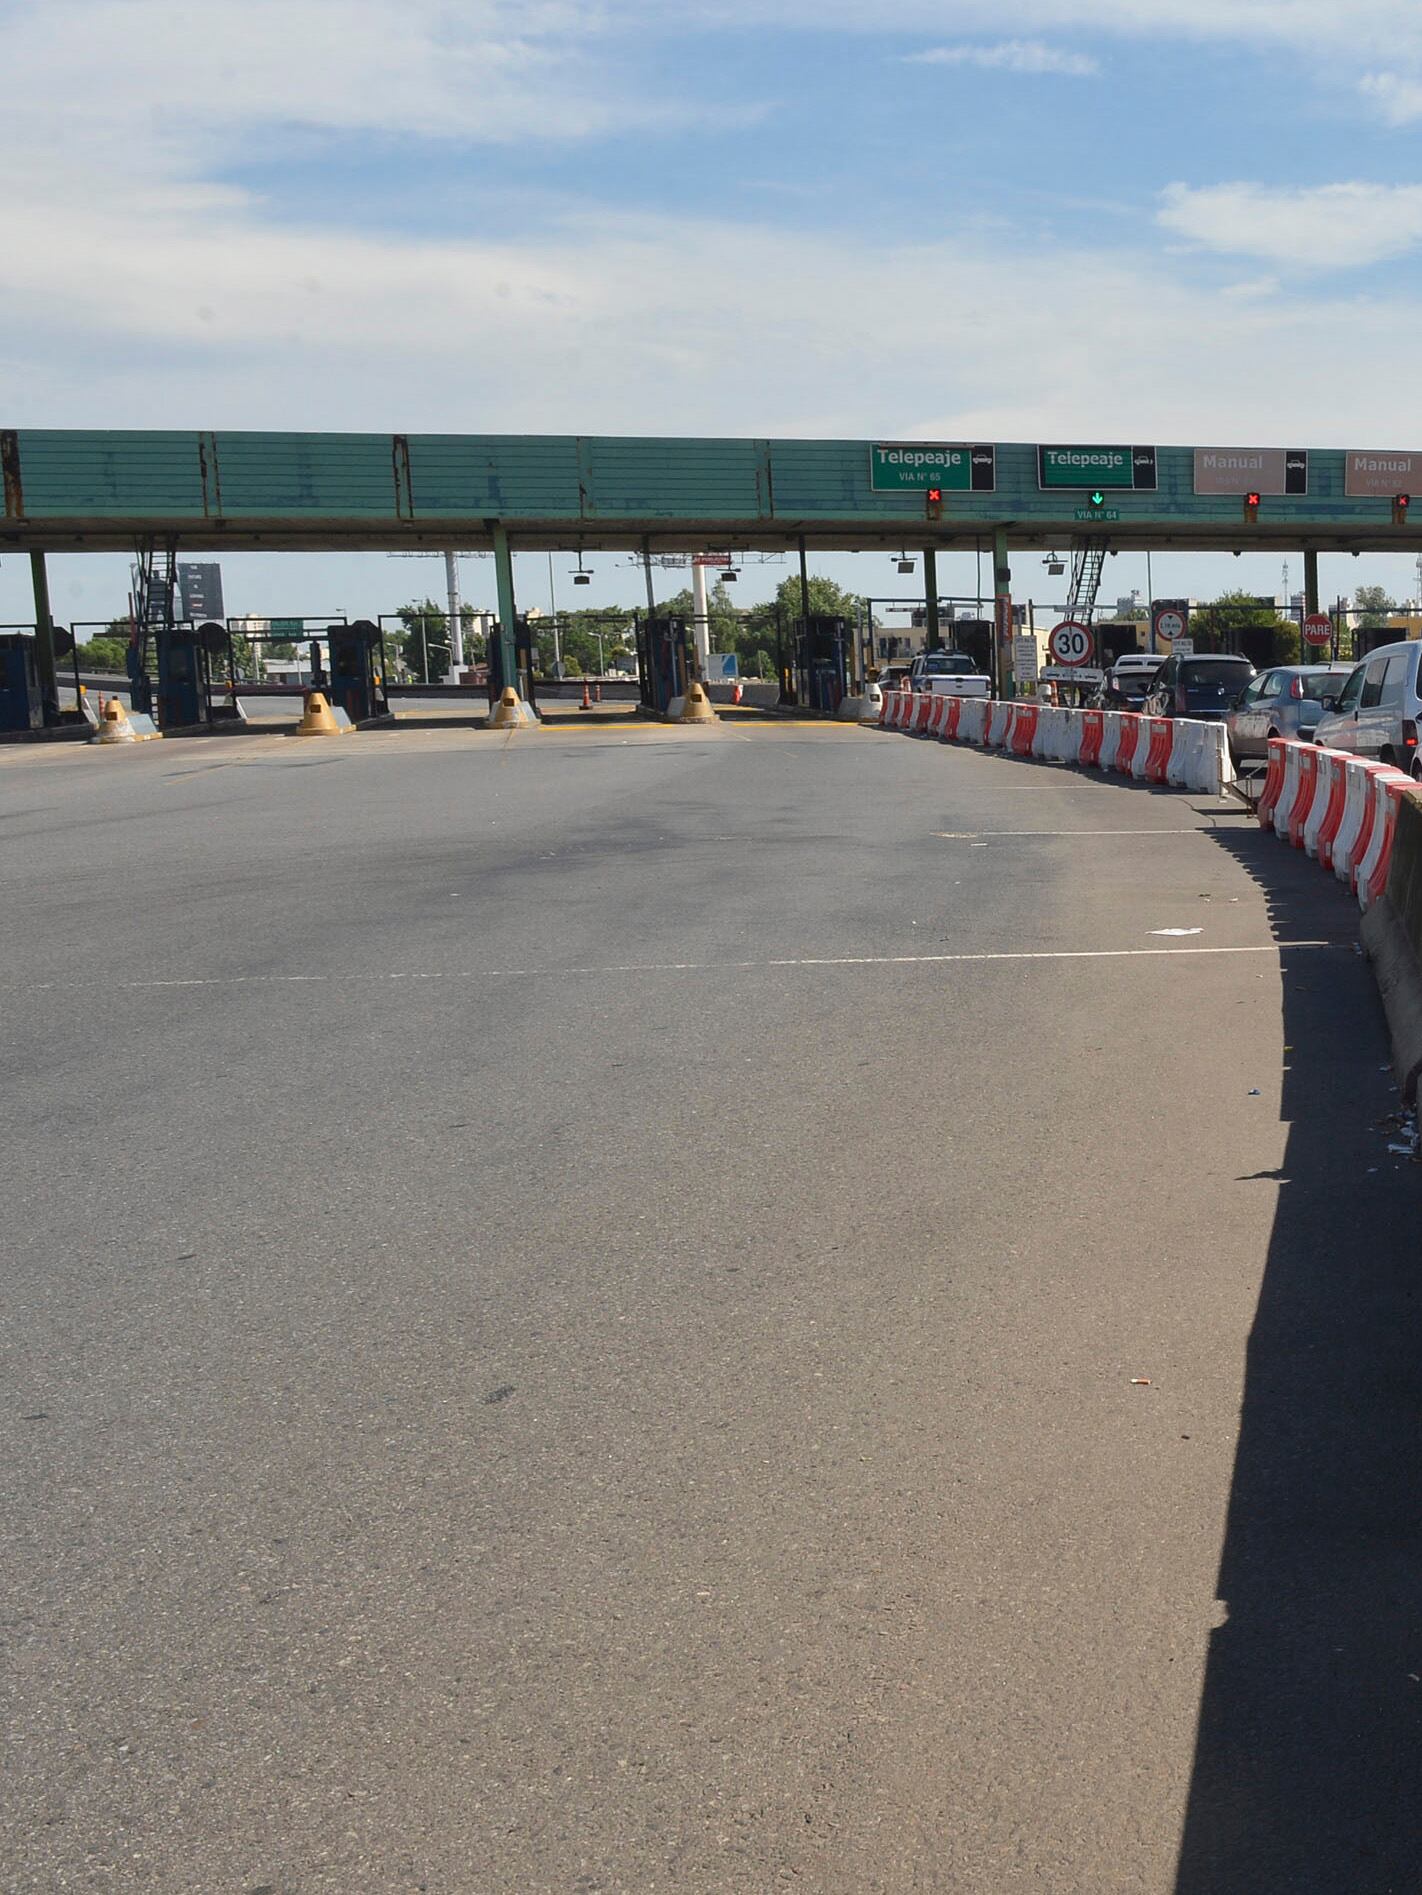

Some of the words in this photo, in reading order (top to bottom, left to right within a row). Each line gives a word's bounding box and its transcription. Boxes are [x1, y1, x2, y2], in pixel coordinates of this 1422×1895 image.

[877, 449, 961, 467] Telepeaje
[1047, 451, 1123, 467] Telepeaje
[1203, 455, 1262, 469] Manual
[1354, 458, 1411, 472] Manual
[899, 472, 915, 481] VIA
[929, 472, 941, 481] 65
[1077, 511, 1092, 520] VIA
[1106, 511, 1117, 520] 64
[1305, 624, 1330, 636] PARE
[1058, 633, 1084, 655] 30
